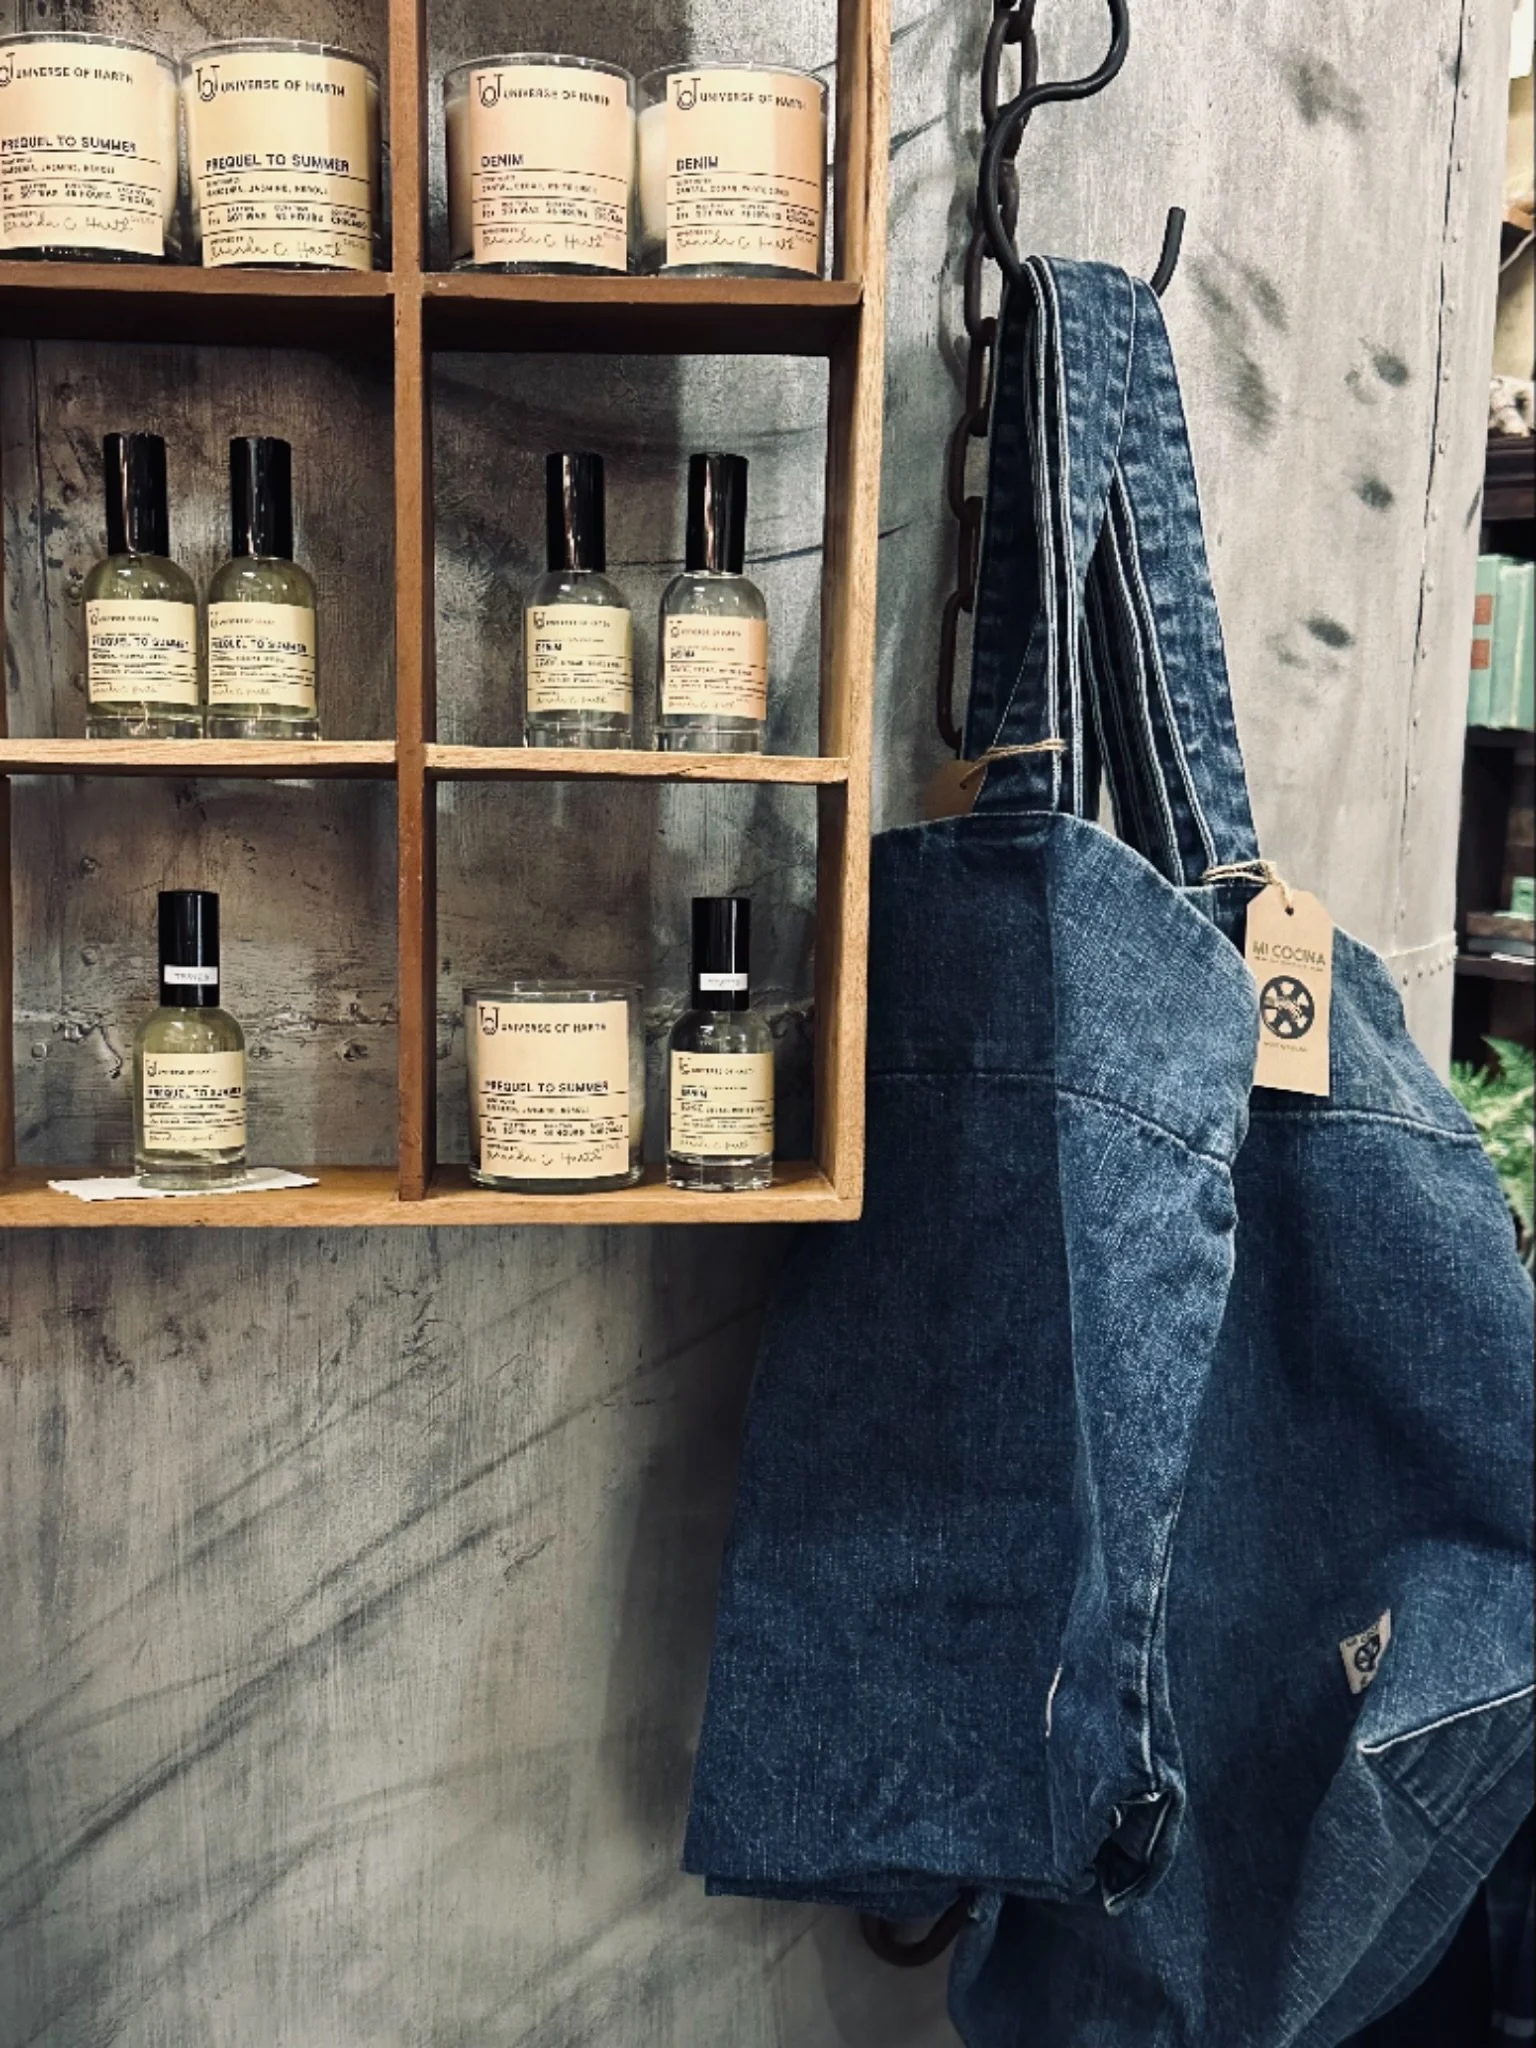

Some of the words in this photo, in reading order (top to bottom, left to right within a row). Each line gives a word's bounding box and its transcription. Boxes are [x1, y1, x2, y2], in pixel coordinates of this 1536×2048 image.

[74, 66, 90, 79] OF
[220, 79, 279, 93] UNIVERSE
[284, 79, 301, 91] OF
[563, 90, 576, 101] OF
[1, 136, 52, 150] PREQUEL
[58, 135, 77, 147] TO
[81, 136, 136, 152] SUMMER
[205, 154, 261, 172] PREQUEL
[266, 153, 286, 166] TO
[292, 154, 349, 173] SUMMER
[480, 153, 524, 168] DENIM
[676, 156, 718, 171] DENIM
[1253, 941, 1269, 957] MI
[1272, 944, 1327, 966] COCINA
[555, 1022, 570, 1034] OF
[485, 1079, 533, 1093] PREQUEL
[537, 1082, 556, 1093] TO
[558, 1079, 609, 1094] SUMMER
